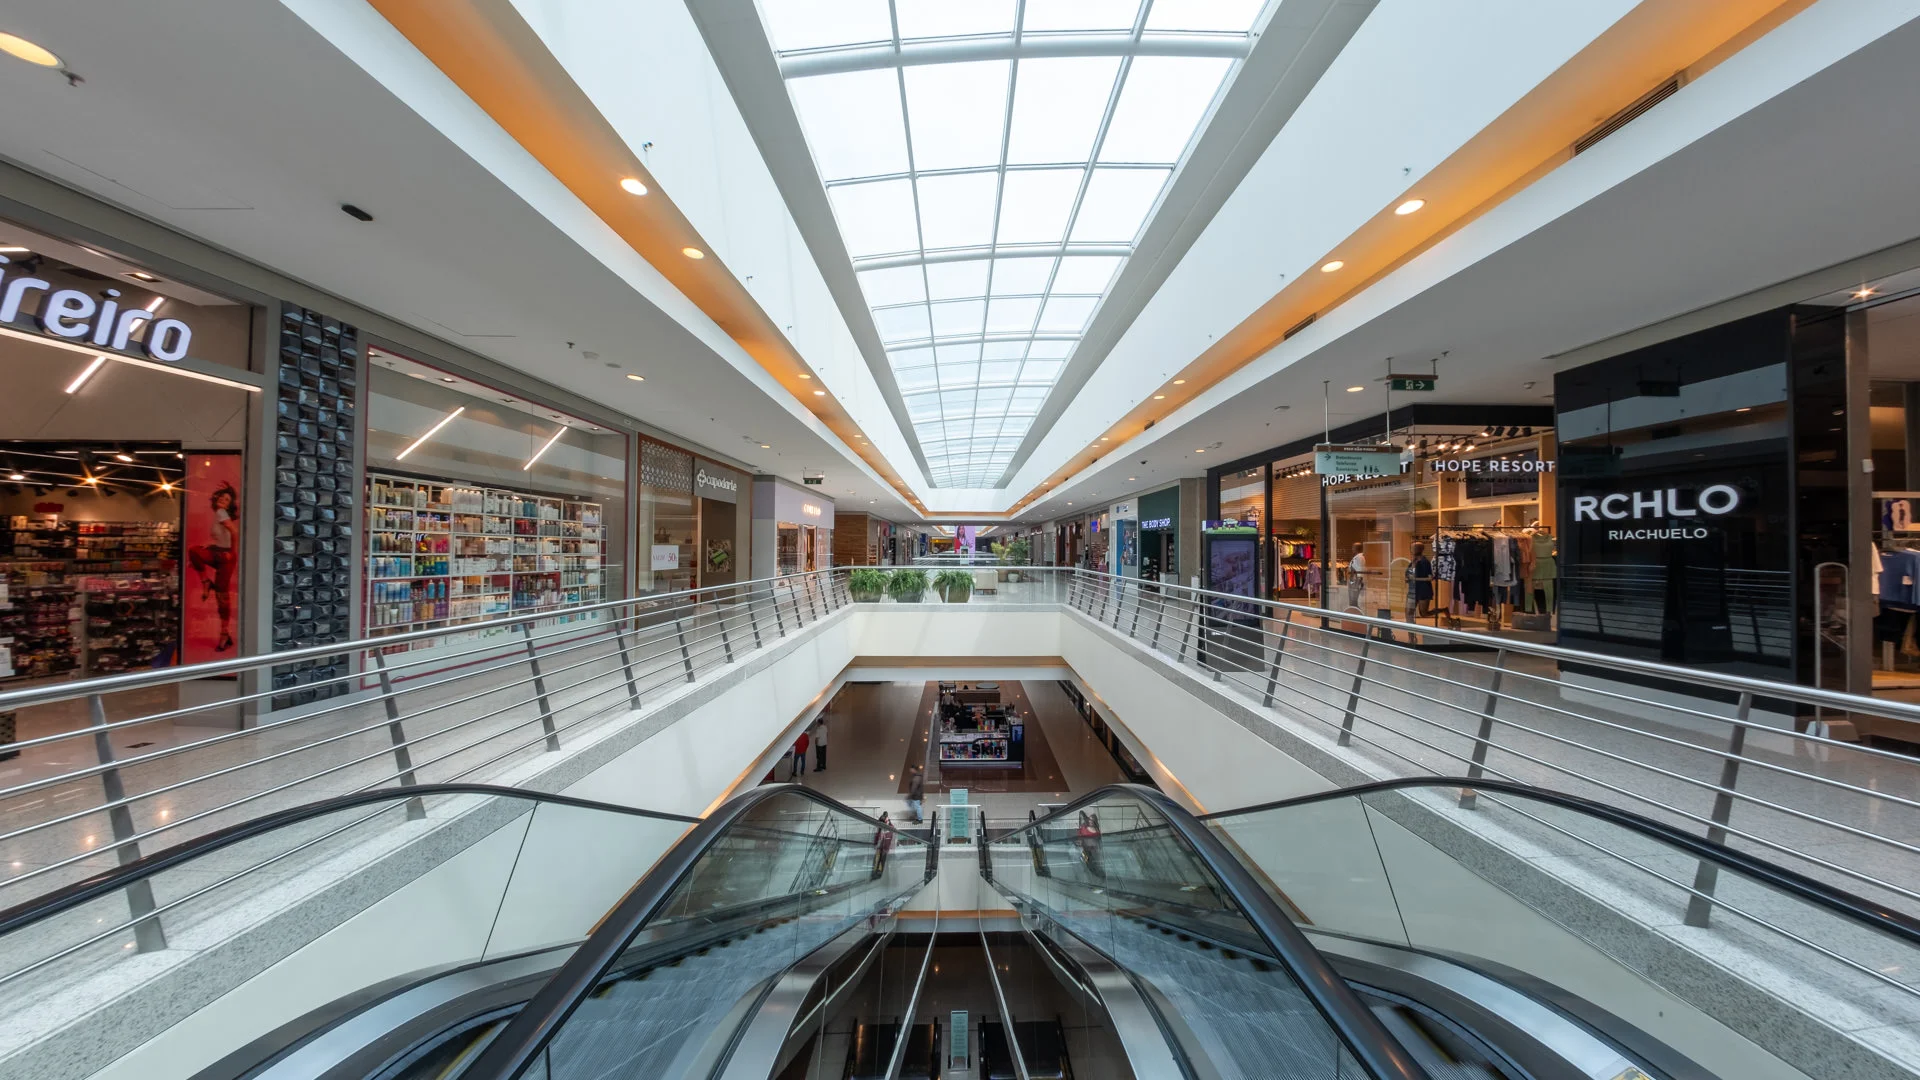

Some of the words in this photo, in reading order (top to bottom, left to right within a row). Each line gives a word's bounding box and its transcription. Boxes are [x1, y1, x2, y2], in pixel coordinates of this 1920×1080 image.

[1435, 460, 1481, 472] HOPE
[1489, 460, 1556, 473] RESORT
[1322, 473, 1351, 487] HOPE
[1573, 484, 1739, 522] RCHLO
[1141, 520, 1149, 529] THE
[1149, 519, 1158, 528] BODY
[1608, 528, 1708, 541] RIACHUELO
